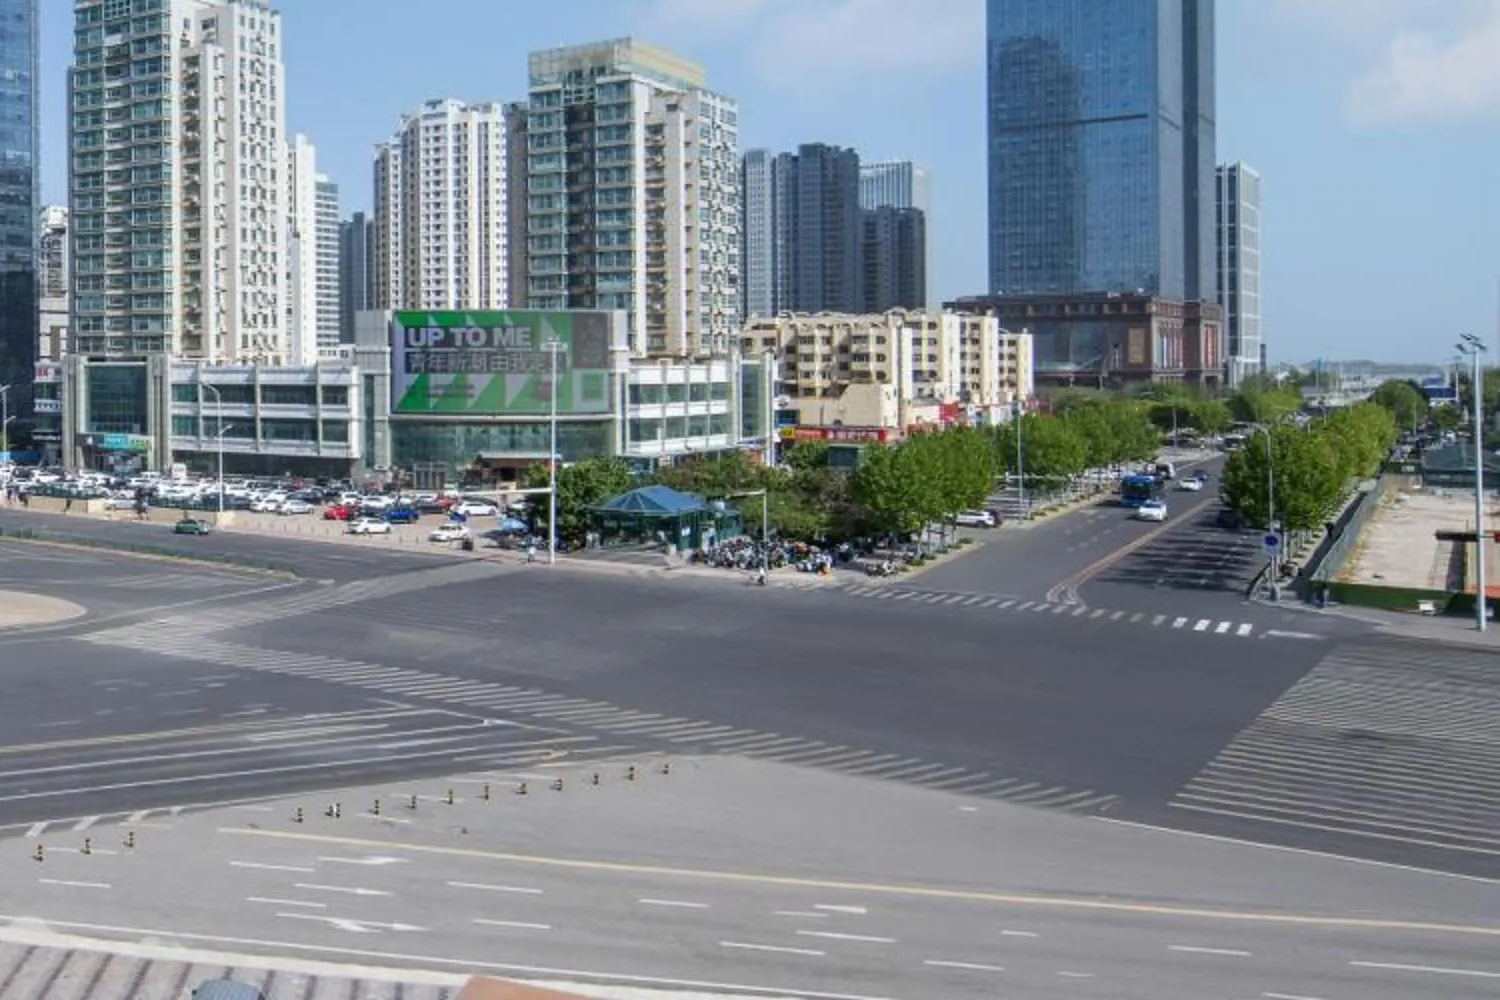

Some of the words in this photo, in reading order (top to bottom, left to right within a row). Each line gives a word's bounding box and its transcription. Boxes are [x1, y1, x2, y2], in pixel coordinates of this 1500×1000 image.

[408, 327, 444, 347] UP
[451, 327, 488, 347] TO
[493, 327, 532, 347] ME
